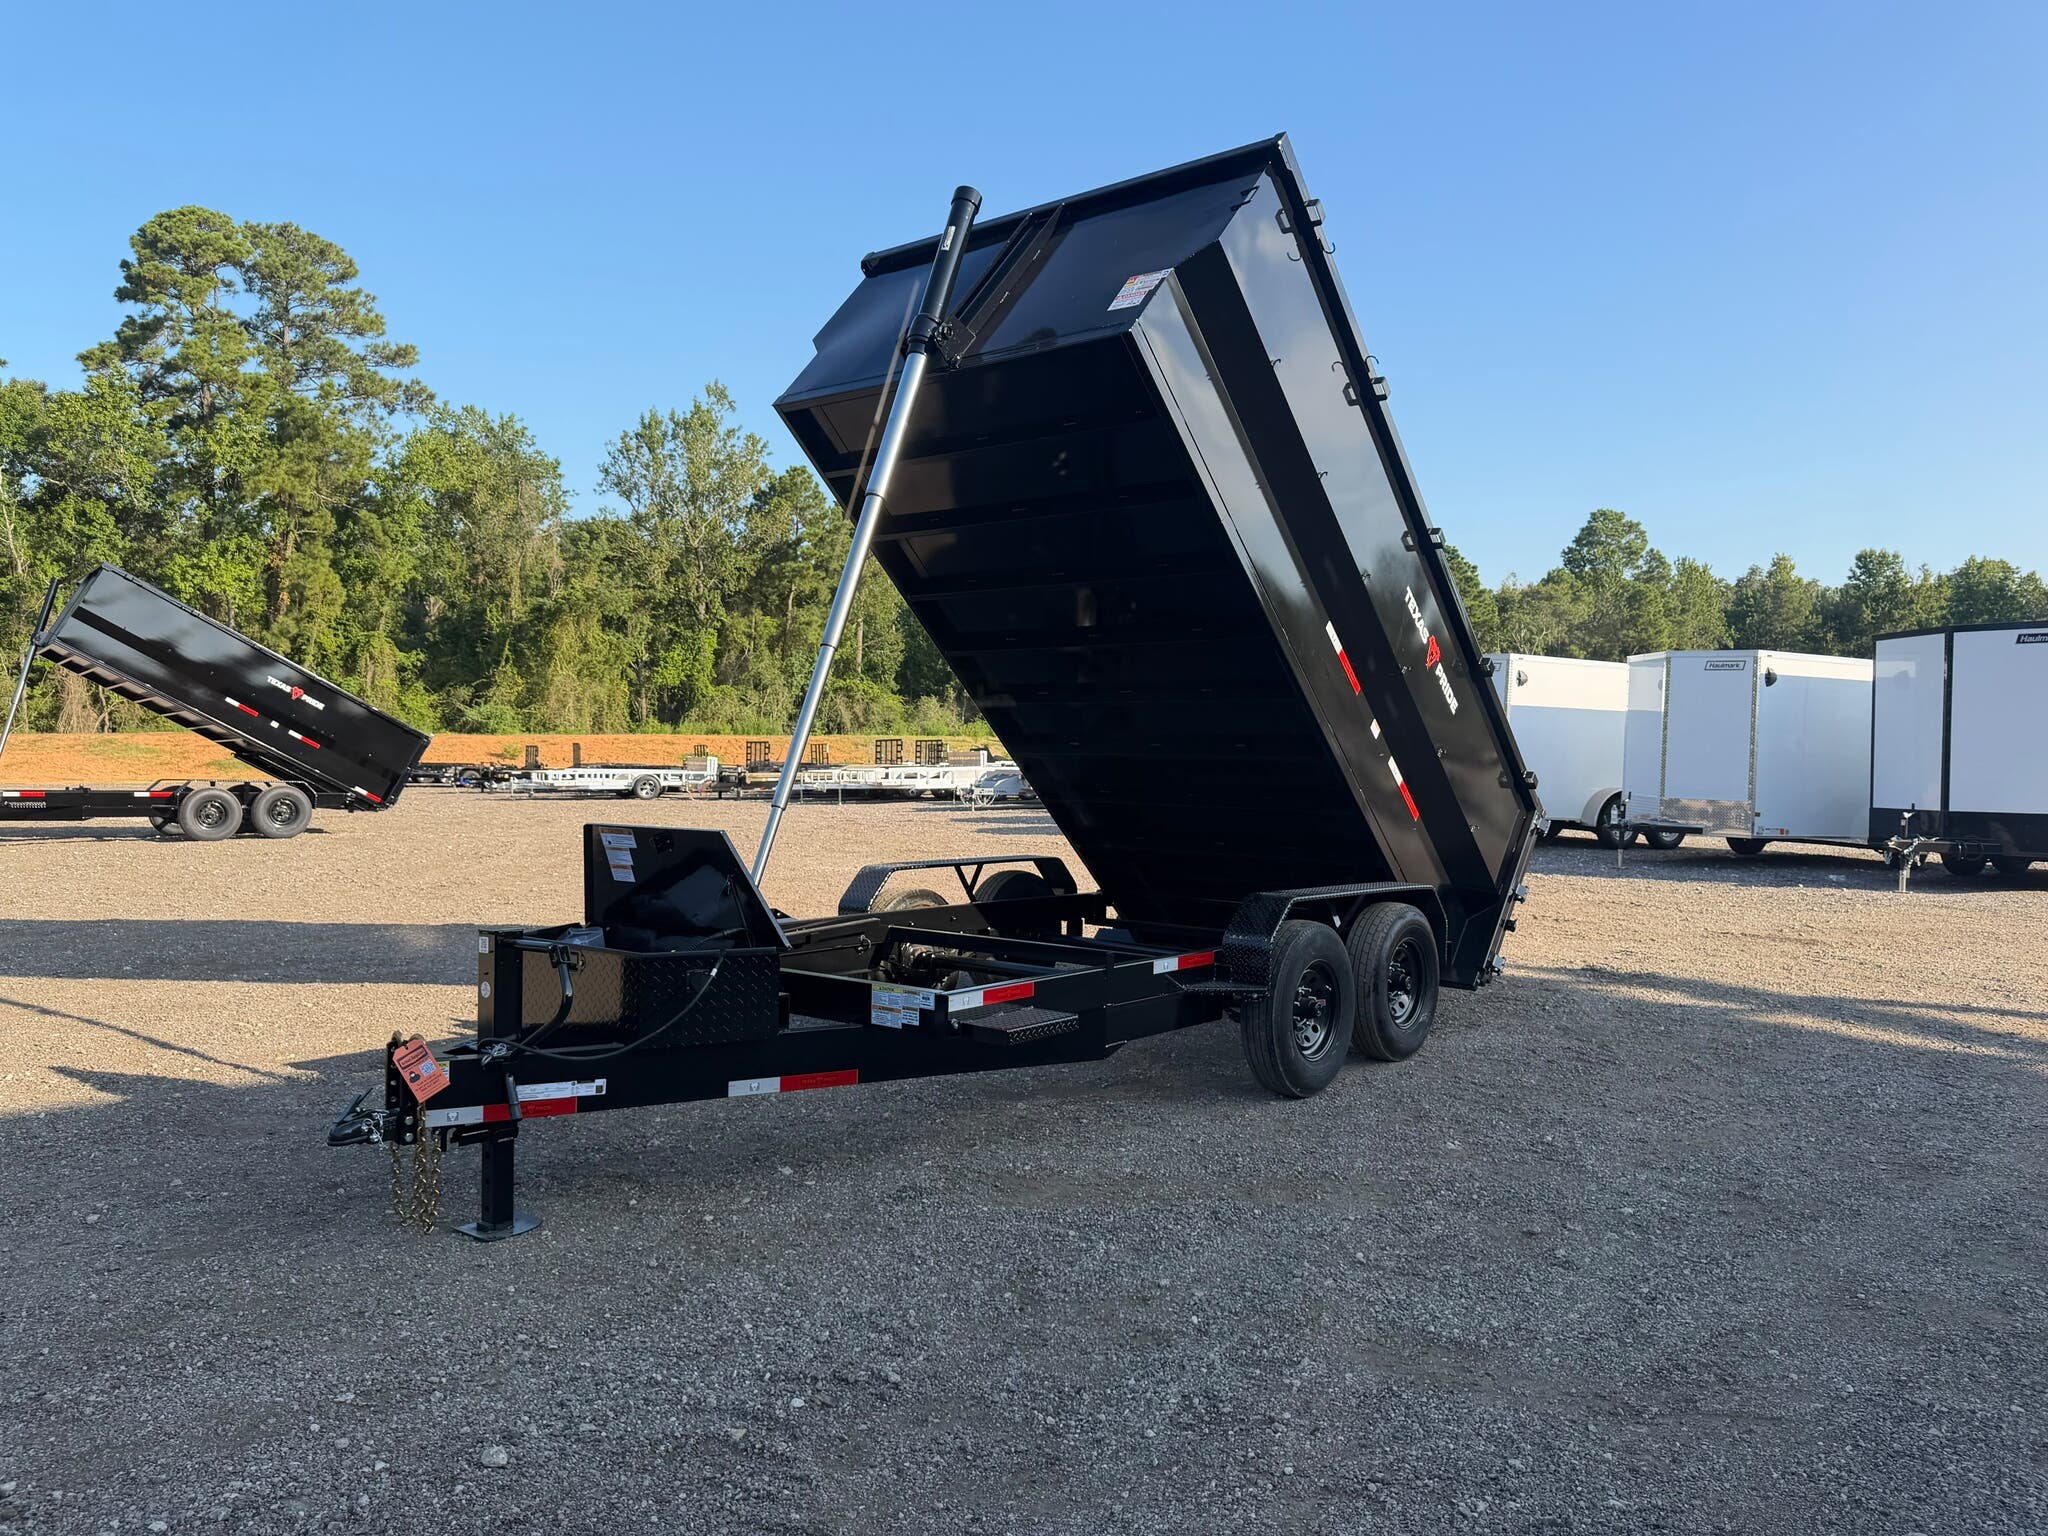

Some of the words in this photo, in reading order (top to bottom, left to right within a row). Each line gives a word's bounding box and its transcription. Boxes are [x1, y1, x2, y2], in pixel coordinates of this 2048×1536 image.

[1404, 586, 1429, 644] TEXAS
[1435, 662, 1459, 715] PRIDE
[267, 675, 292, 693] TEXAS
[301, 694, 325, 711] PRIDE
